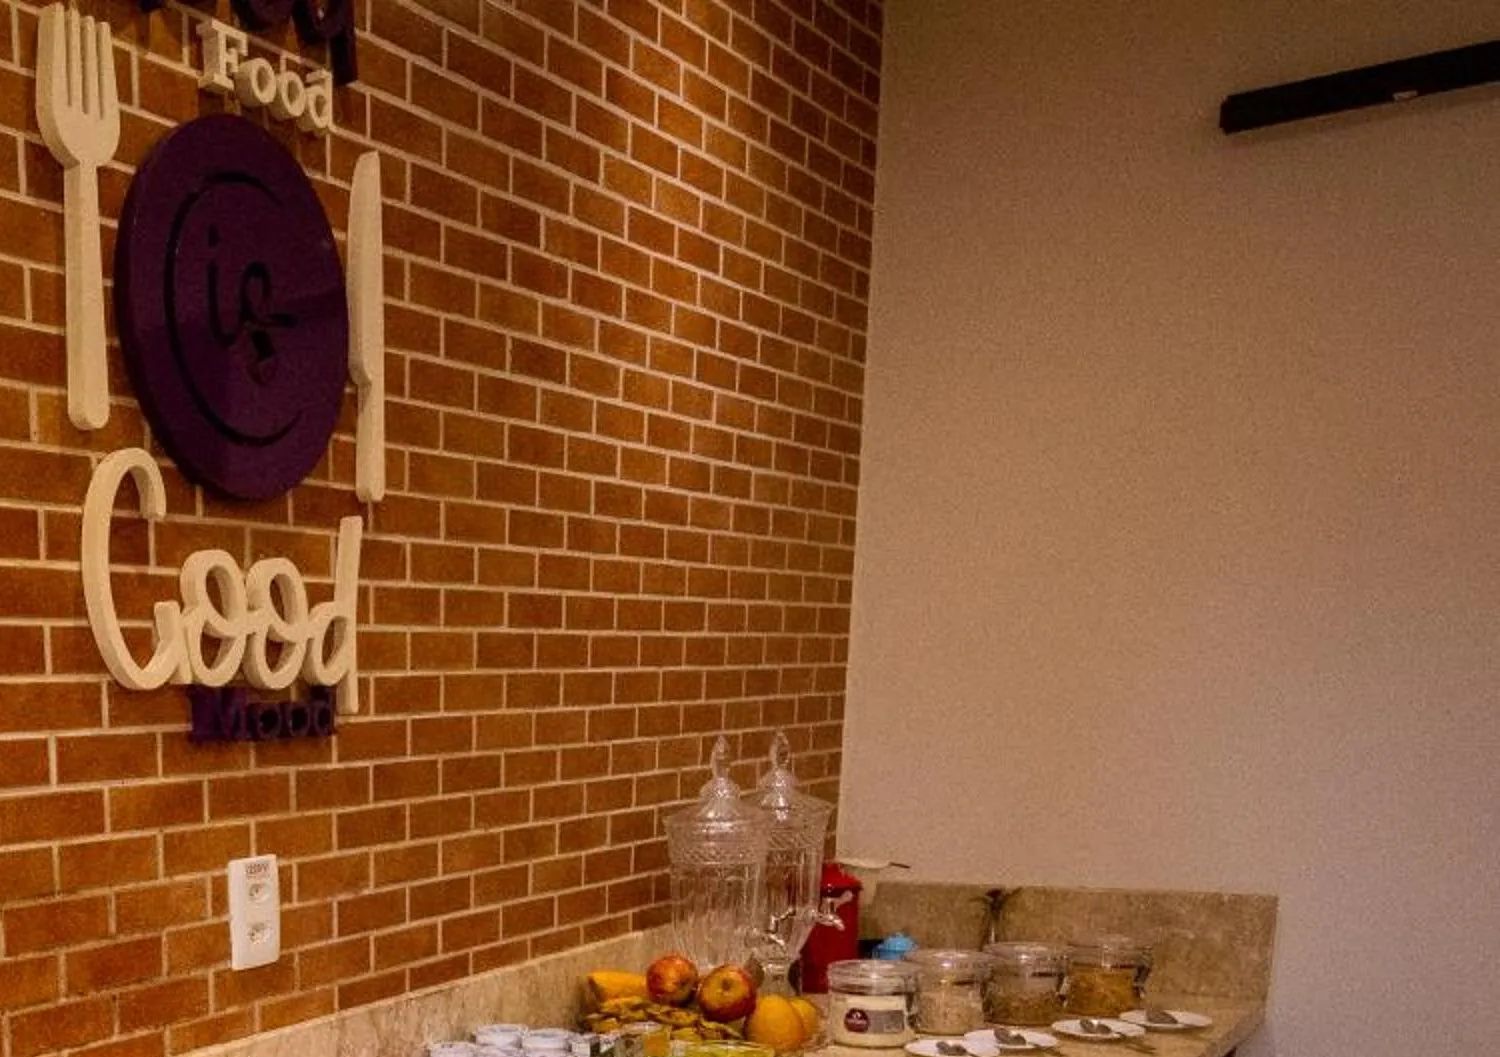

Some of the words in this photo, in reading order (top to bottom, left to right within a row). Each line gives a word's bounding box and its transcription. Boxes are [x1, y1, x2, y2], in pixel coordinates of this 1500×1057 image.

[197, 18, 333, 136] Food
[81, 447, 363, 714] Good
[188, 683, 337, 744] Mood
